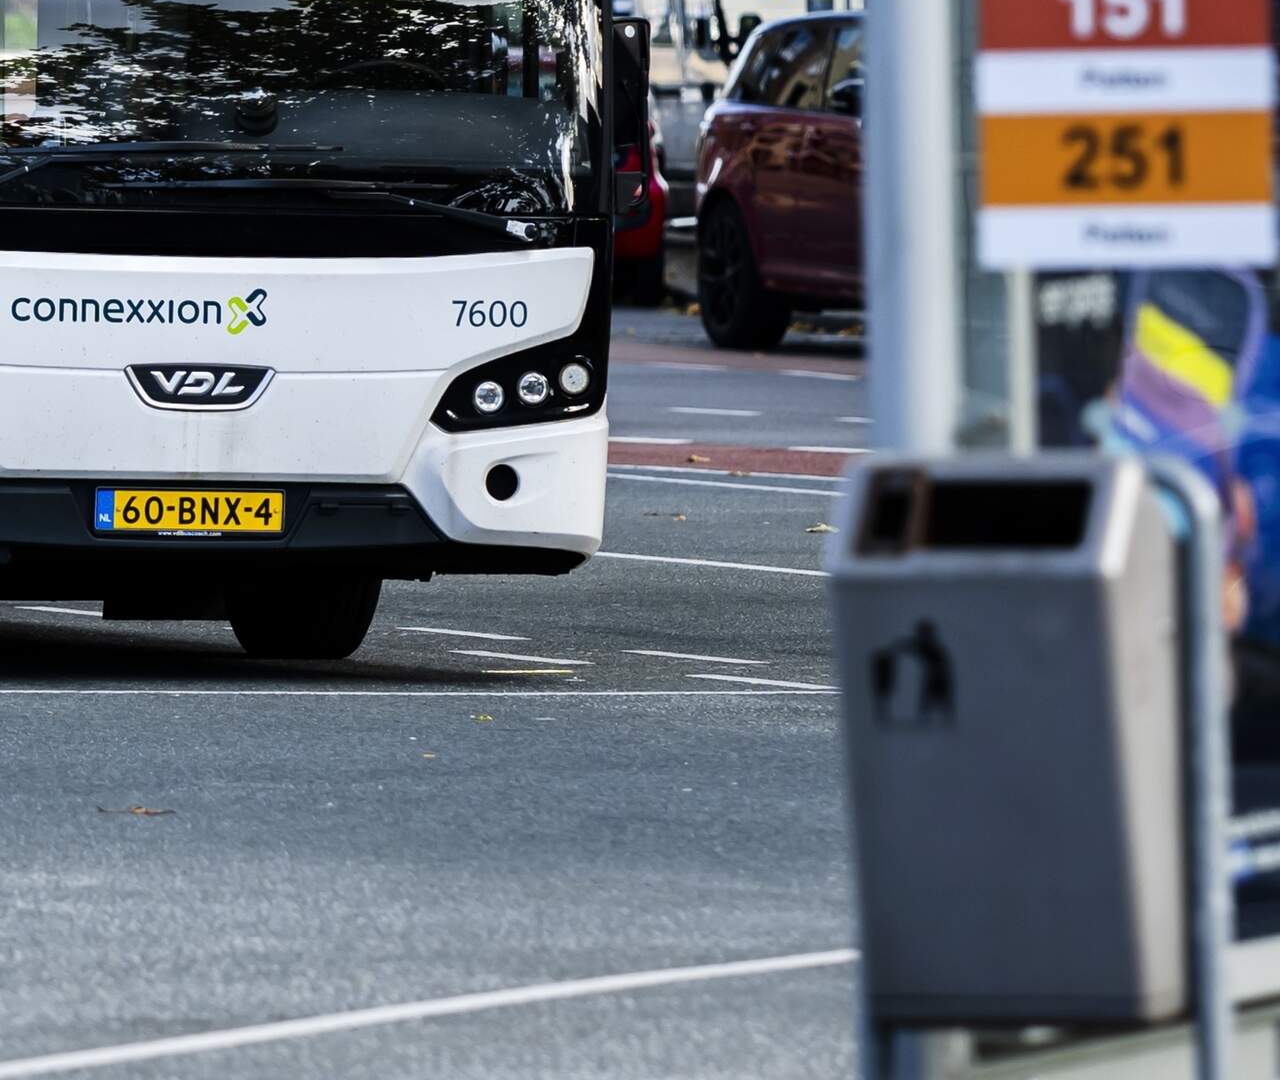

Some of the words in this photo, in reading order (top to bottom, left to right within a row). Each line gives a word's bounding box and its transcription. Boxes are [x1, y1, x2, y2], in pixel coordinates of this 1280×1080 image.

[1062, 125, 1186, 191] 251
[11, 296, 222, 326] connexxion
[452, 300, 528, 328] 7600
[150, 371, 245, 396] VDL
[99, 513, 112, 523] NL
[122, 496, 273, 526] 60-BNX-4
